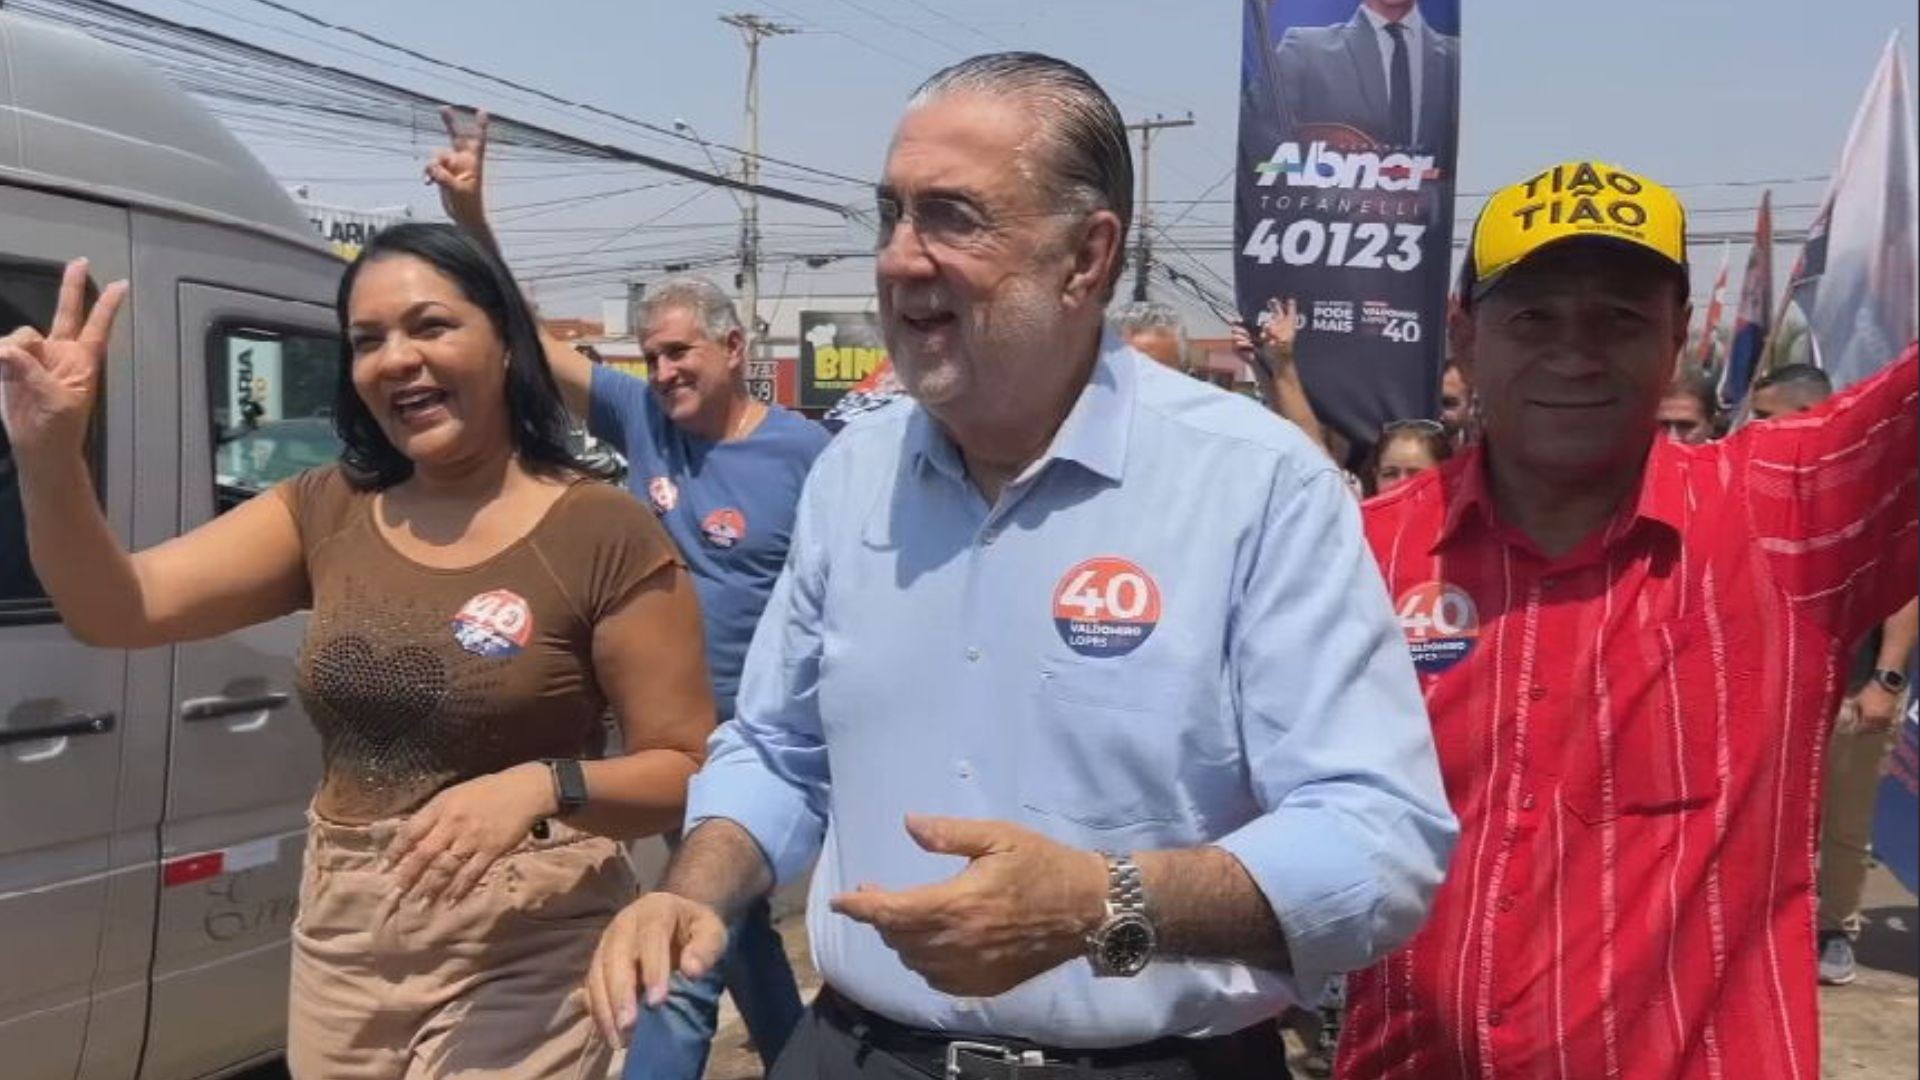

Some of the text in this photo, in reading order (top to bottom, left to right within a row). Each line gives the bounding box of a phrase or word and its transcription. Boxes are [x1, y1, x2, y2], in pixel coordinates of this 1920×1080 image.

[1255, 141, 1436, 191] Abner
[1260, 195, 1419, 216] TOFANELLI
[1513, 186, 1647, 231] TIÃO
[1242, 218, 1427, 272] 40123
[1313, 307, 1353, 320] PODE
[1313, 319, 1353, 333] MAIS
[1382, 319, 1421, 343] 40
[814, 347, 888, 381] BIN
[1059, 570, 1148, 619] 40
[459, 594, 524, 635] 40
[1070, 620, 1142, 637] VALDOMIRO
[1400, 592, 1469, 636] 40
[1069, 635, 1108, 648] LOPES
